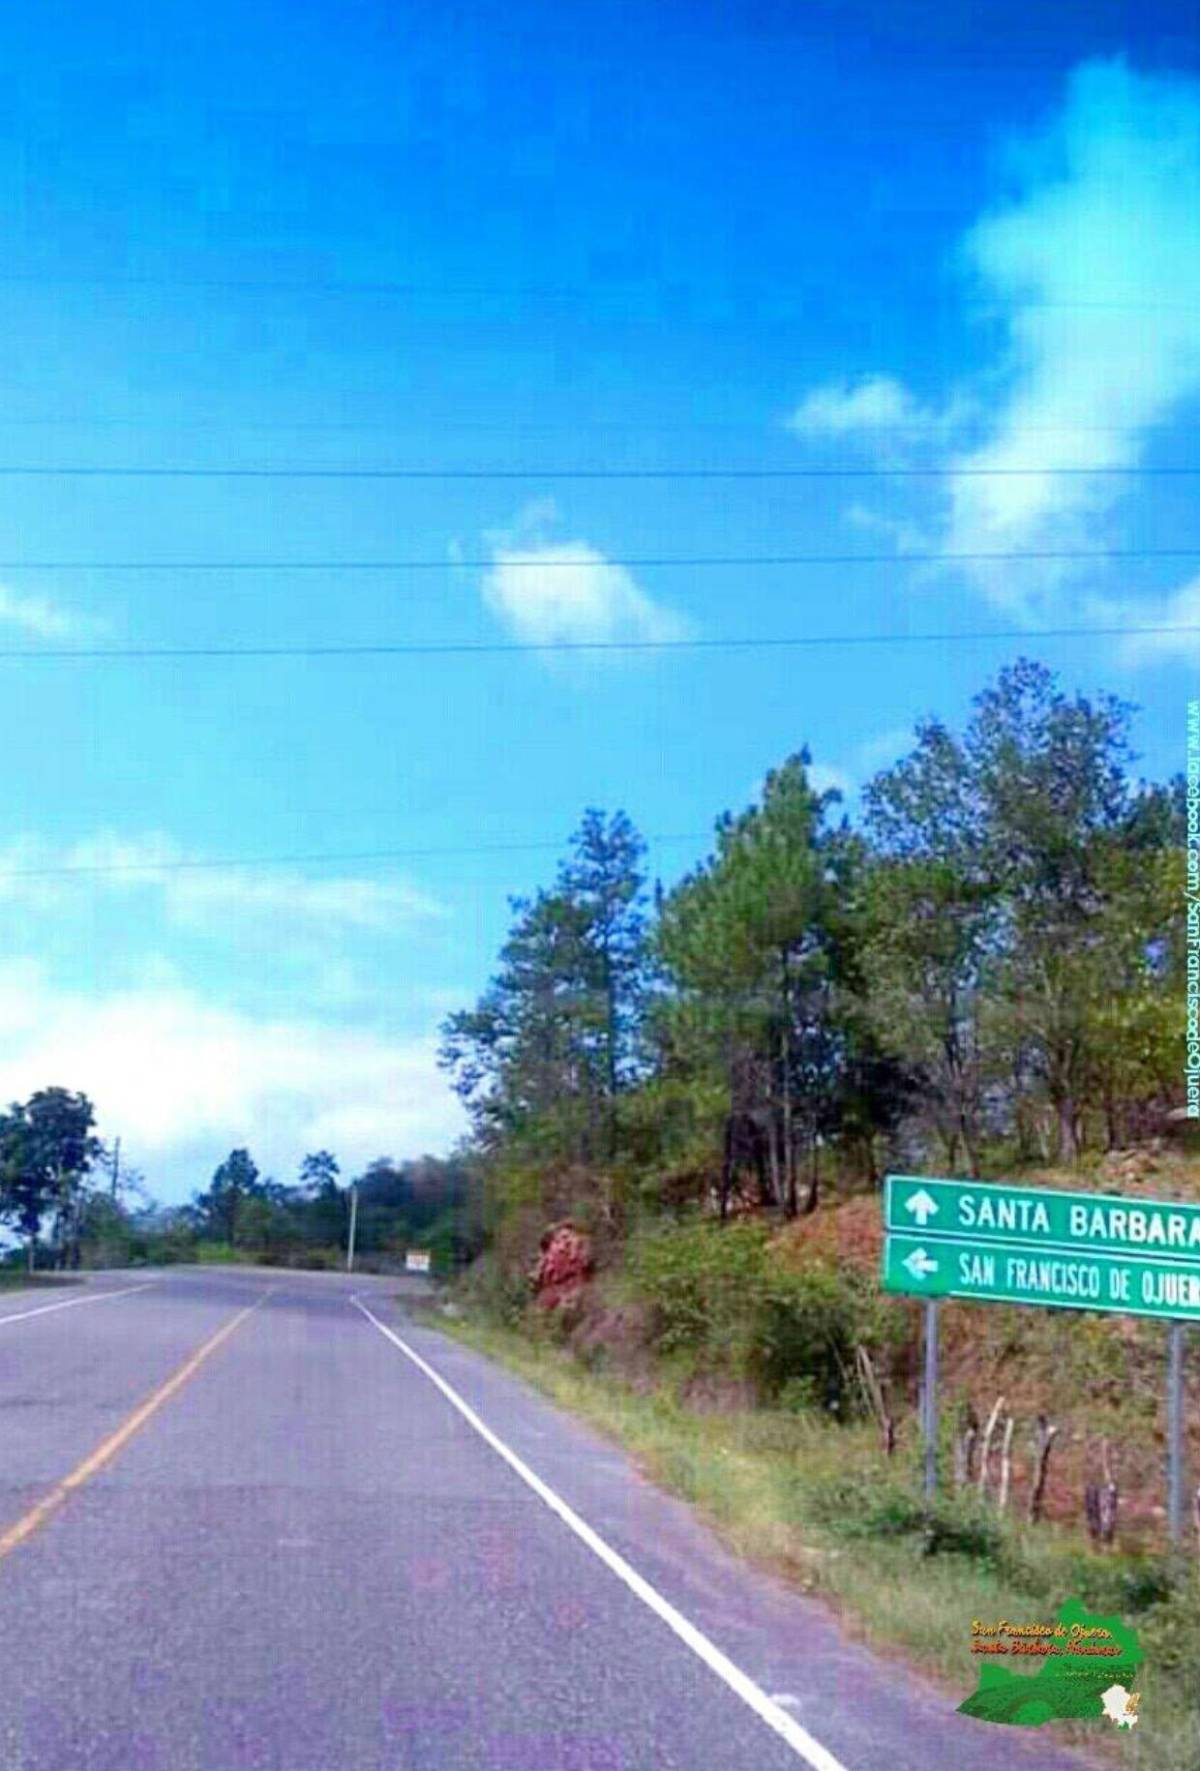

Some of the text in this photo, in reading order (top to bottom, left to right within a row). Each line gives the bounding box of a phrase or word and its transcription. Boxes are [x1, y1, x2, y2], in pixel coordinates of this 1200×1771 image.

[959, 1194, 1200, 1248] SANTA BARBARA
[959, 1252, 995, 1286] SAN
[1006, 1258, 1100, 1298] FRANCISCO
[1109, 1267, 1132, 1301] DE
